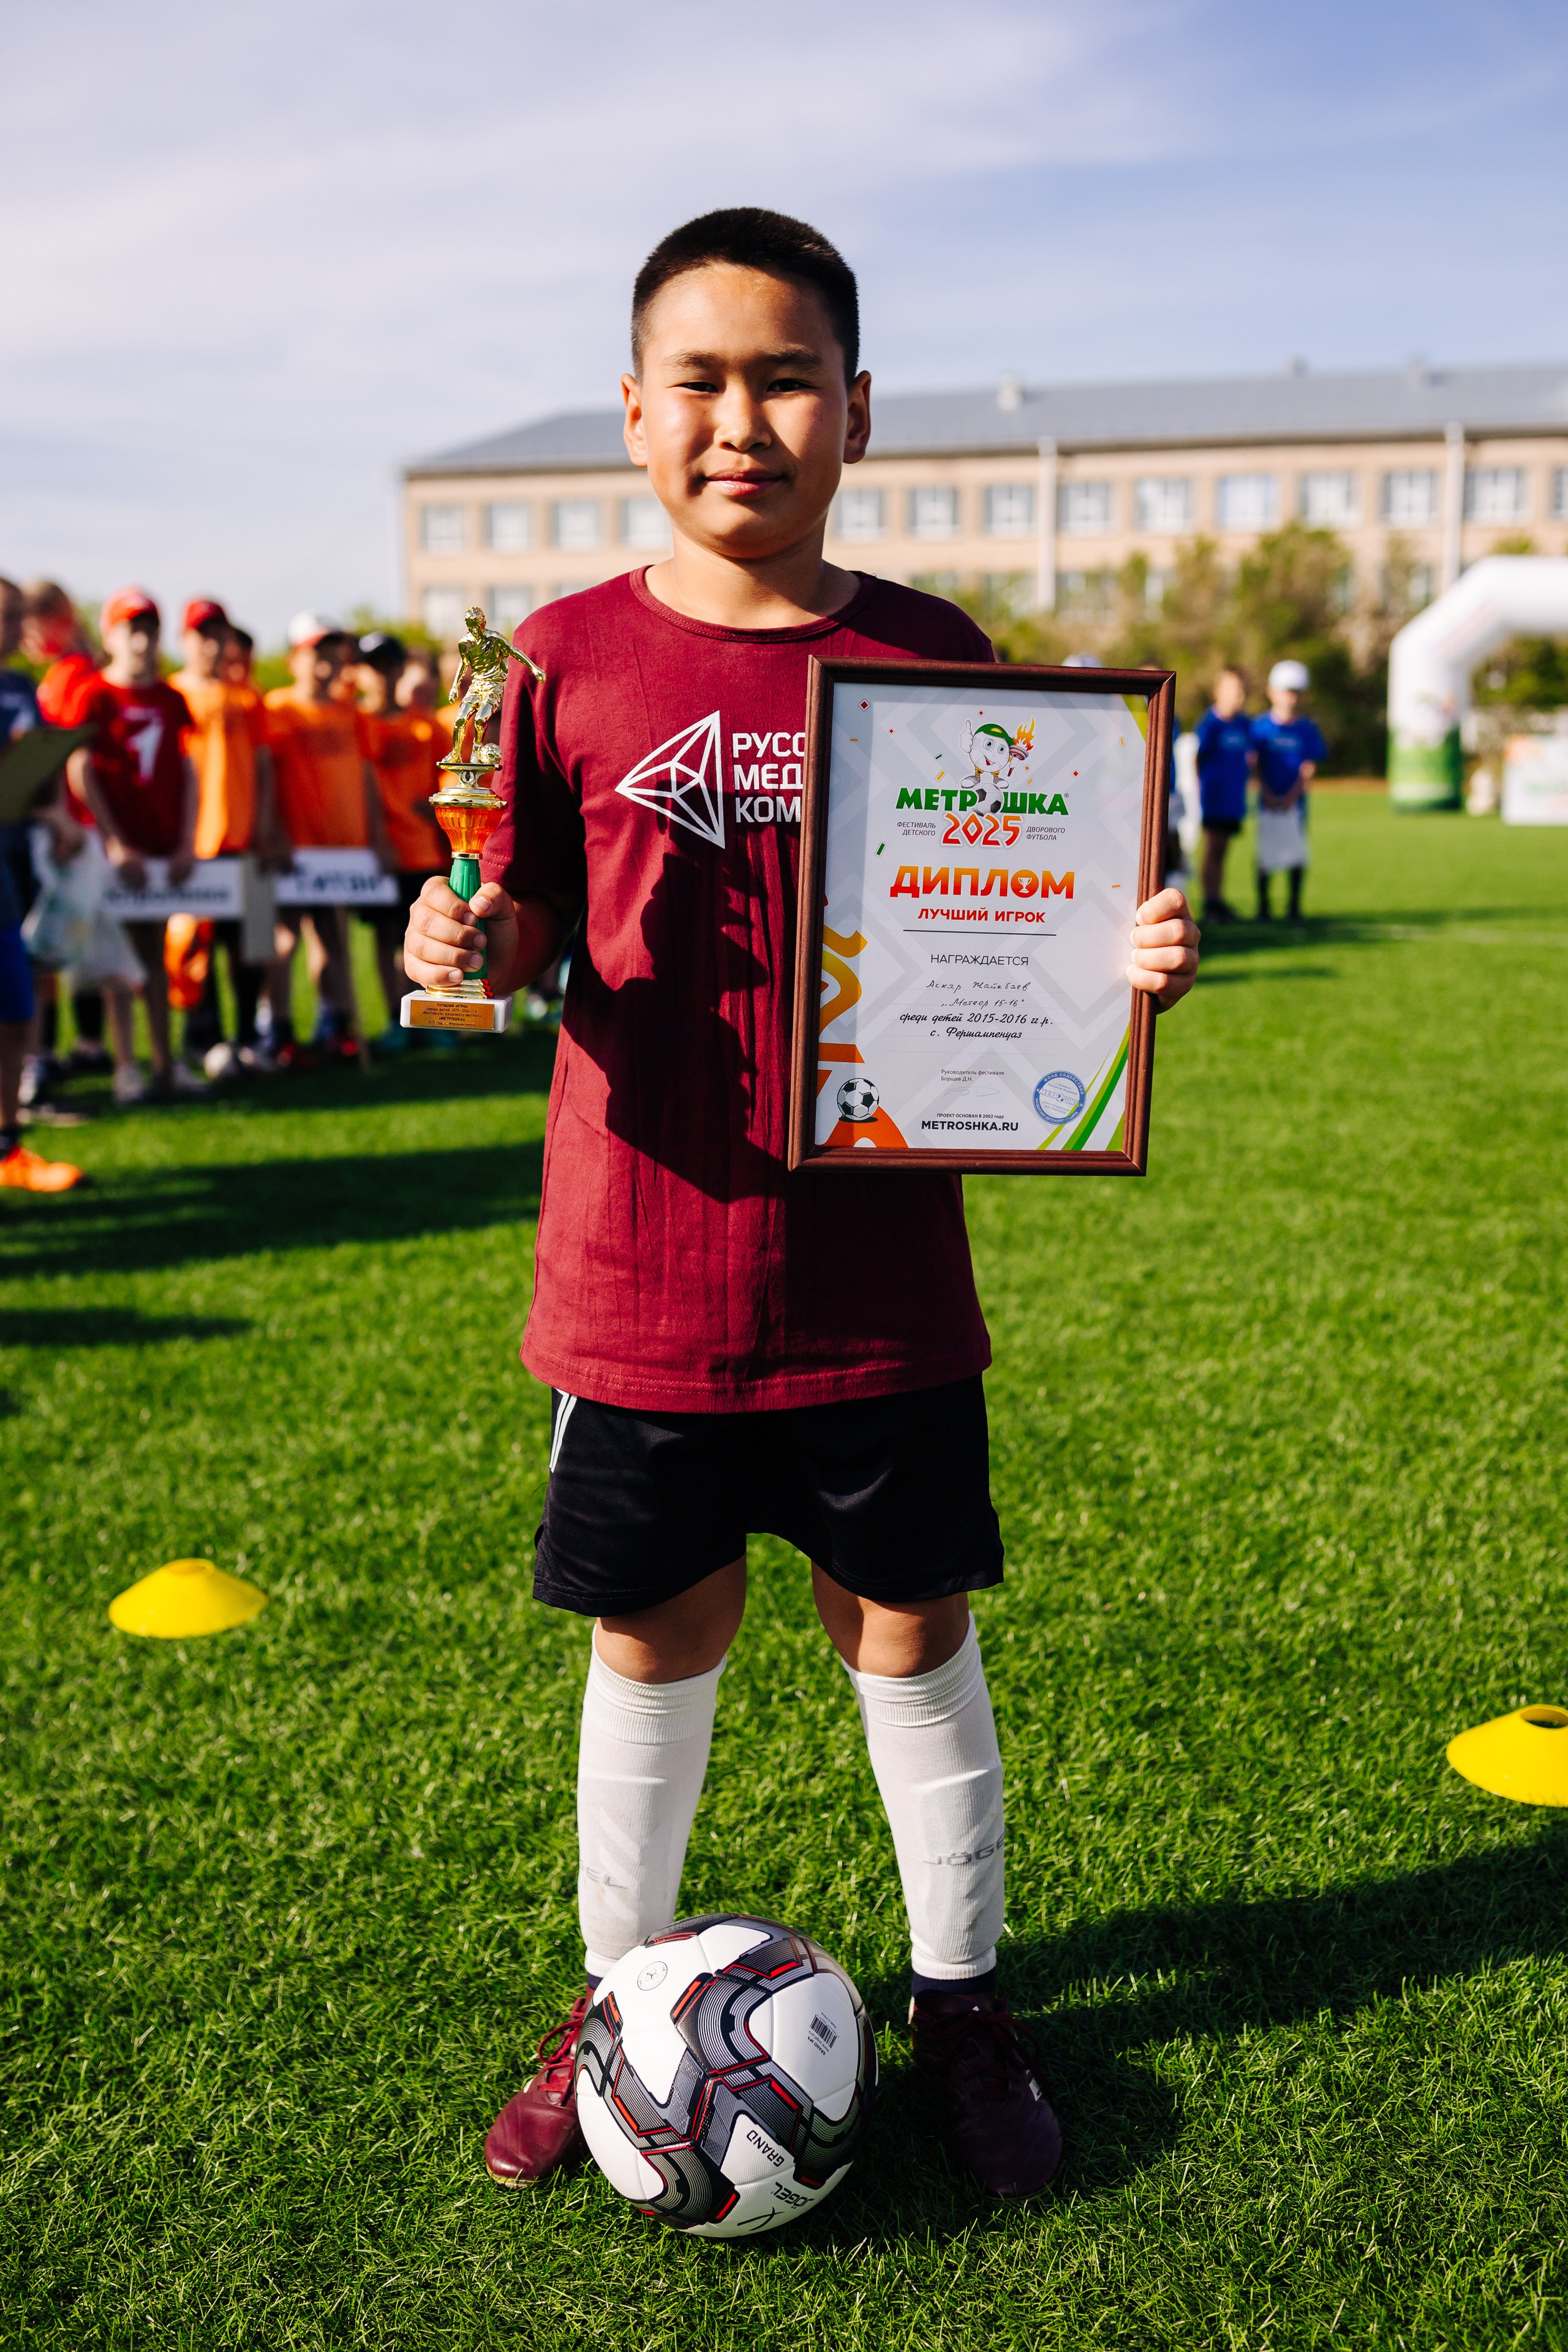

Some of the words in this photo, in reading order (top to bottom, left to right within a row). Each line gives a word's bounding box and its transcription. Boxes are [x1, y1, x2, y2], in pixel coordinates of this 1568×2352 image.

[733, 763, 803, 790] МЕД
[735, 796, 801, 823] КОМ
[942, 812, 1022, 846] 2025
[889, 865, 1076, 899] ДИПЛОМ
[918, 907, 989, 921] ЛУЧШИЙ
[994, 910, 1046, 923] ИГРОК
[930, 954, 1029, 966] НАГРАЖДАЕТСЯ
[900, 1012, 927, 1023] среди
[932, 1012, 963, 1023] детей
[967, 1013, 1027, 1024] 2015-2016
[946, 1026, 1022, 1041] Фершампенуаз
[1044, 1073, 1058, 1082] ФОНД
[1059, 1072, 1084, 1095] СОДЕЙСТВИЯ
[921, 1120, 1019, 1131] METROSHKA.RU
[813, 2042, 826, 2056] GRAND
[746, 2130, 785, 2168] GRAND
[773, 2181, 815, 2210] JÖGEL
